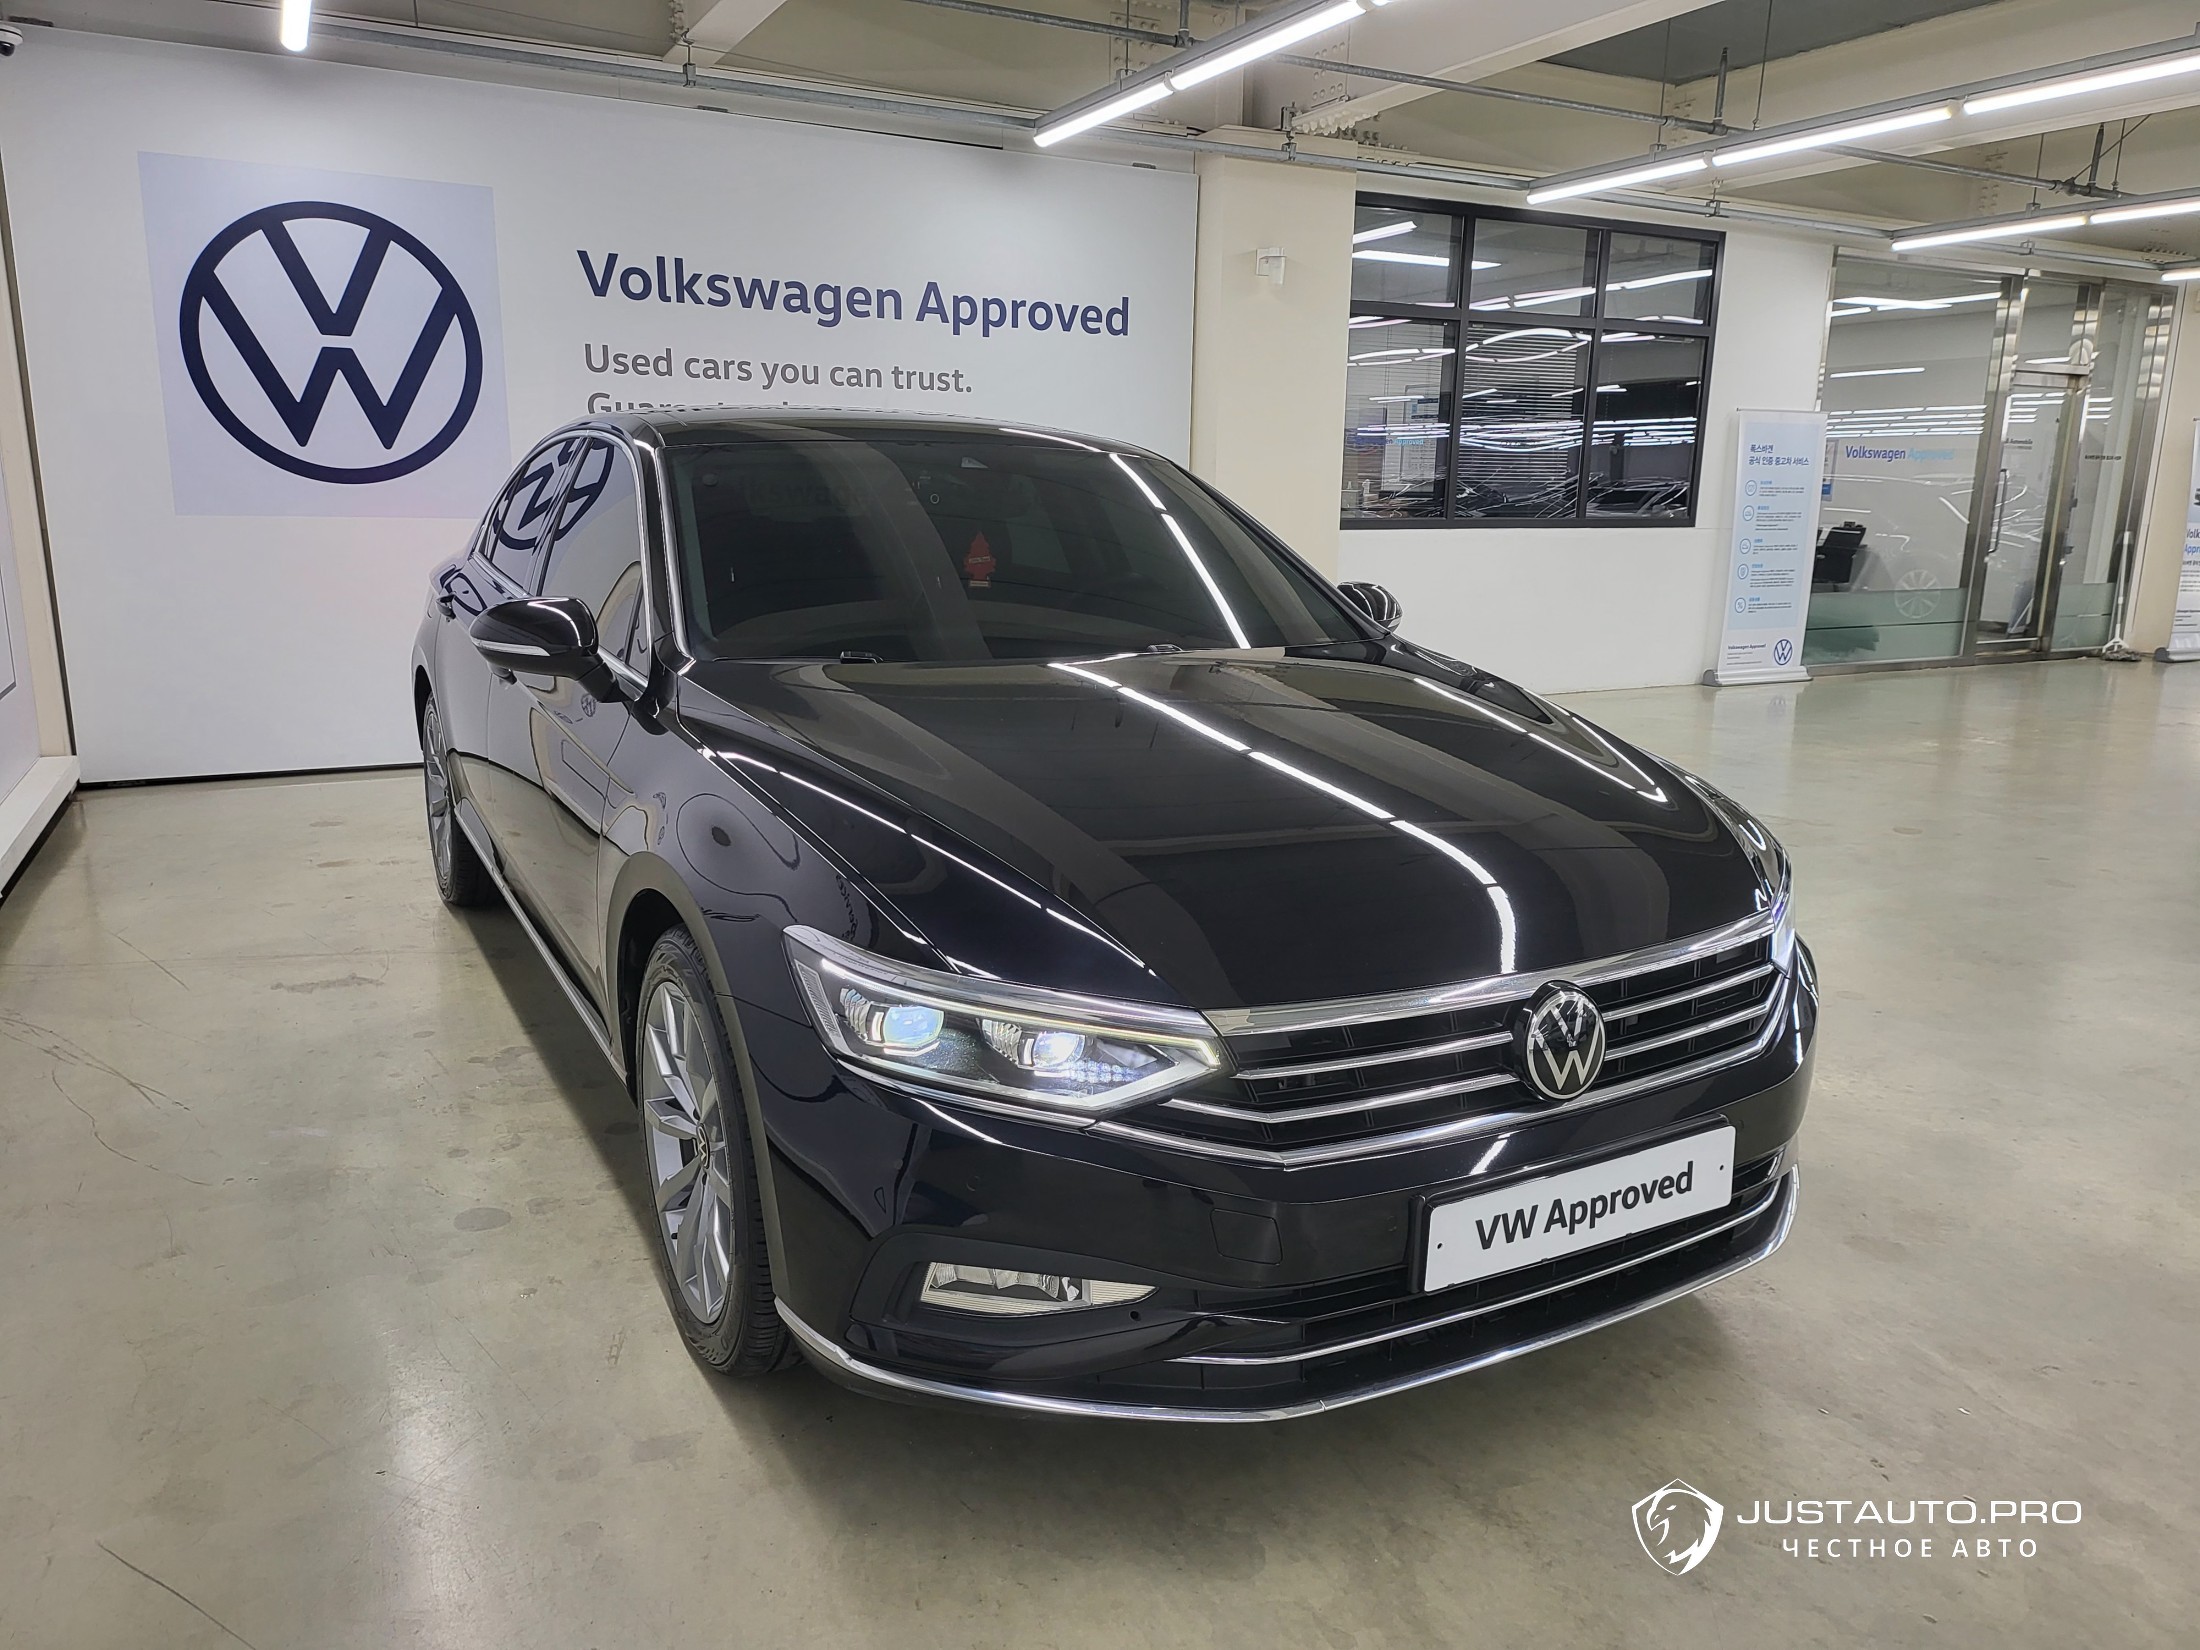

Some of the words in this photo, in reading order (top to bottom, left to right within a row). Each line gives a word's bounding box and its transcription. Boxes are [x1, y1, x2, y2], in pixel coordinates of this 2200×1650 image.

[576, 250, 902, 328] Volkswagen
[916, 281, 1130, 338] Approved
[584, 343, 673, 378] Used
[684, 357, 752, 381] cars
[760, 359, 820, 390] you
[829, 366, 884, 388] can
[891, 366, 973, 393] trust.
[1750, 444, 1774, 454] 폭스바겐
[1775, 456, 1792, 466] 중고차
[1792, 456, 1809, 466] 서비스
[1845, 445, 1906, 462] Volkswagen
[1475, 1205, 1538, 1250] VW
[1543, 1161, 1694, 1234] Approved
